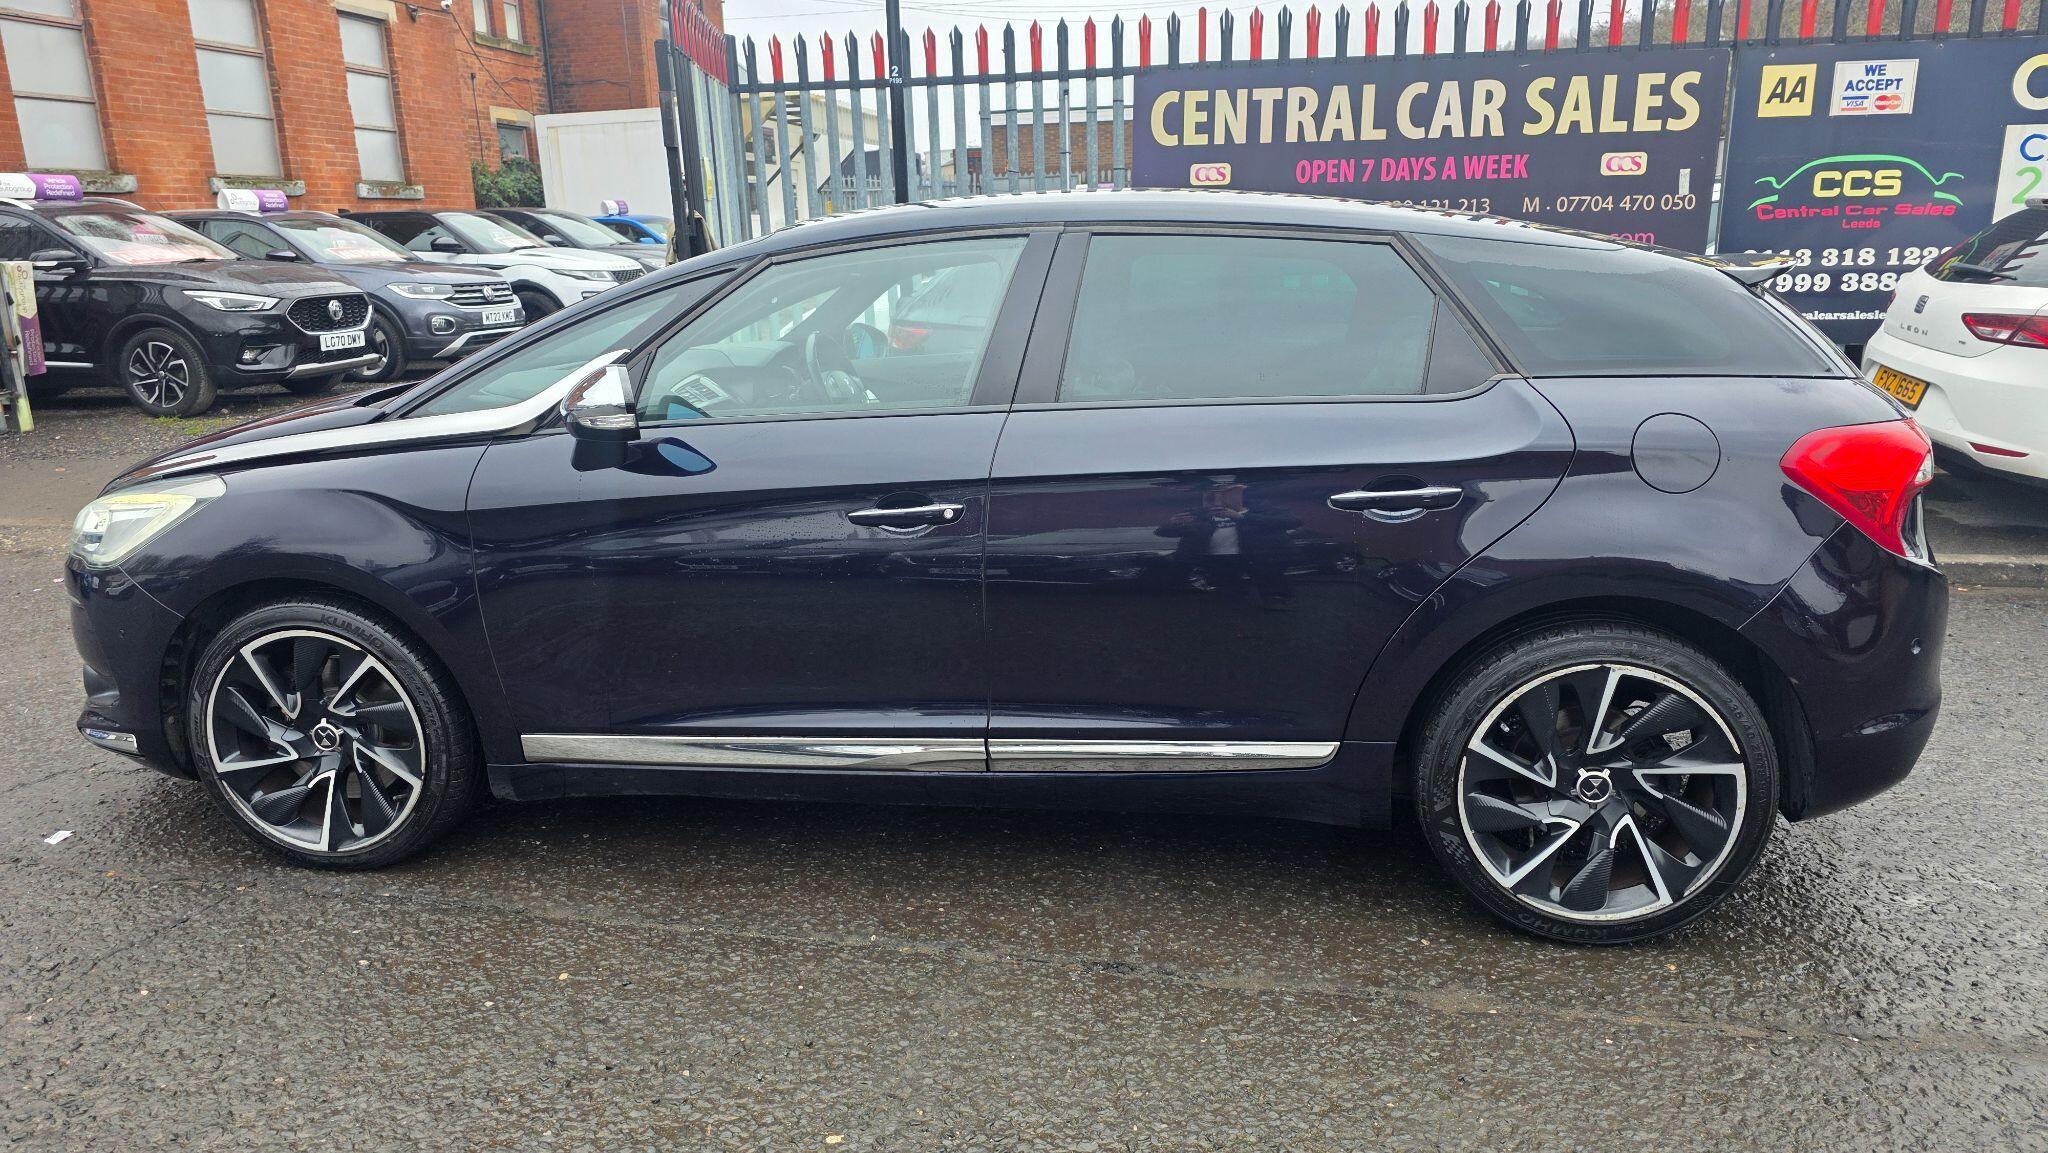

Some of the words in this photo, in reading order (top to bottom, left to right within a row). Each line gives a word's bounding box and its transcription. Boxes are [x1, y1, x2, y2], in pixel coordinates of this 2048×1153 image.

[891, 65, 899, 77] 2
[1864, 63, 1888, 77] WE
[1765, 75, 1807, 105] AA
[1844, 77, 1904, 92] ACCEPT
[1151, 83, 1387, 147] CENTRAL
[1396, 80, 1506, 141] CAR
[1523, 71, 1702, 137] SALES
[2019, 133, 2048, 162] C
[1295, 158, 1355, 184] OPEN
[1361, 159, 1376, 183] 7
[1380, 156, 1437, 182] DAYS
[1441, 156, 1458, 180] A
[1463, 154, 1530, 180] WEEK
[1812, 169, 1902, 198] CCS
[1458, 198, 1490, 214] 213
[1522, 196, 1540, 213] M
[1556, 195, 1614, 212] 07704
[1619, 194, 1655, 211] 470
[1660, 194, 1696, 211] 050
[1757, 204, 1839, 220] Central
[1845, 204, 1889, 216] Car
[1894, 202, 1957, 216] Sales
[1841, 218, 1881, 230] Leeds
[1821, 247, 1876, 267] 318
[1900, 323, 1929, 336] LEON
[324, 336, 346, 348] LG70
